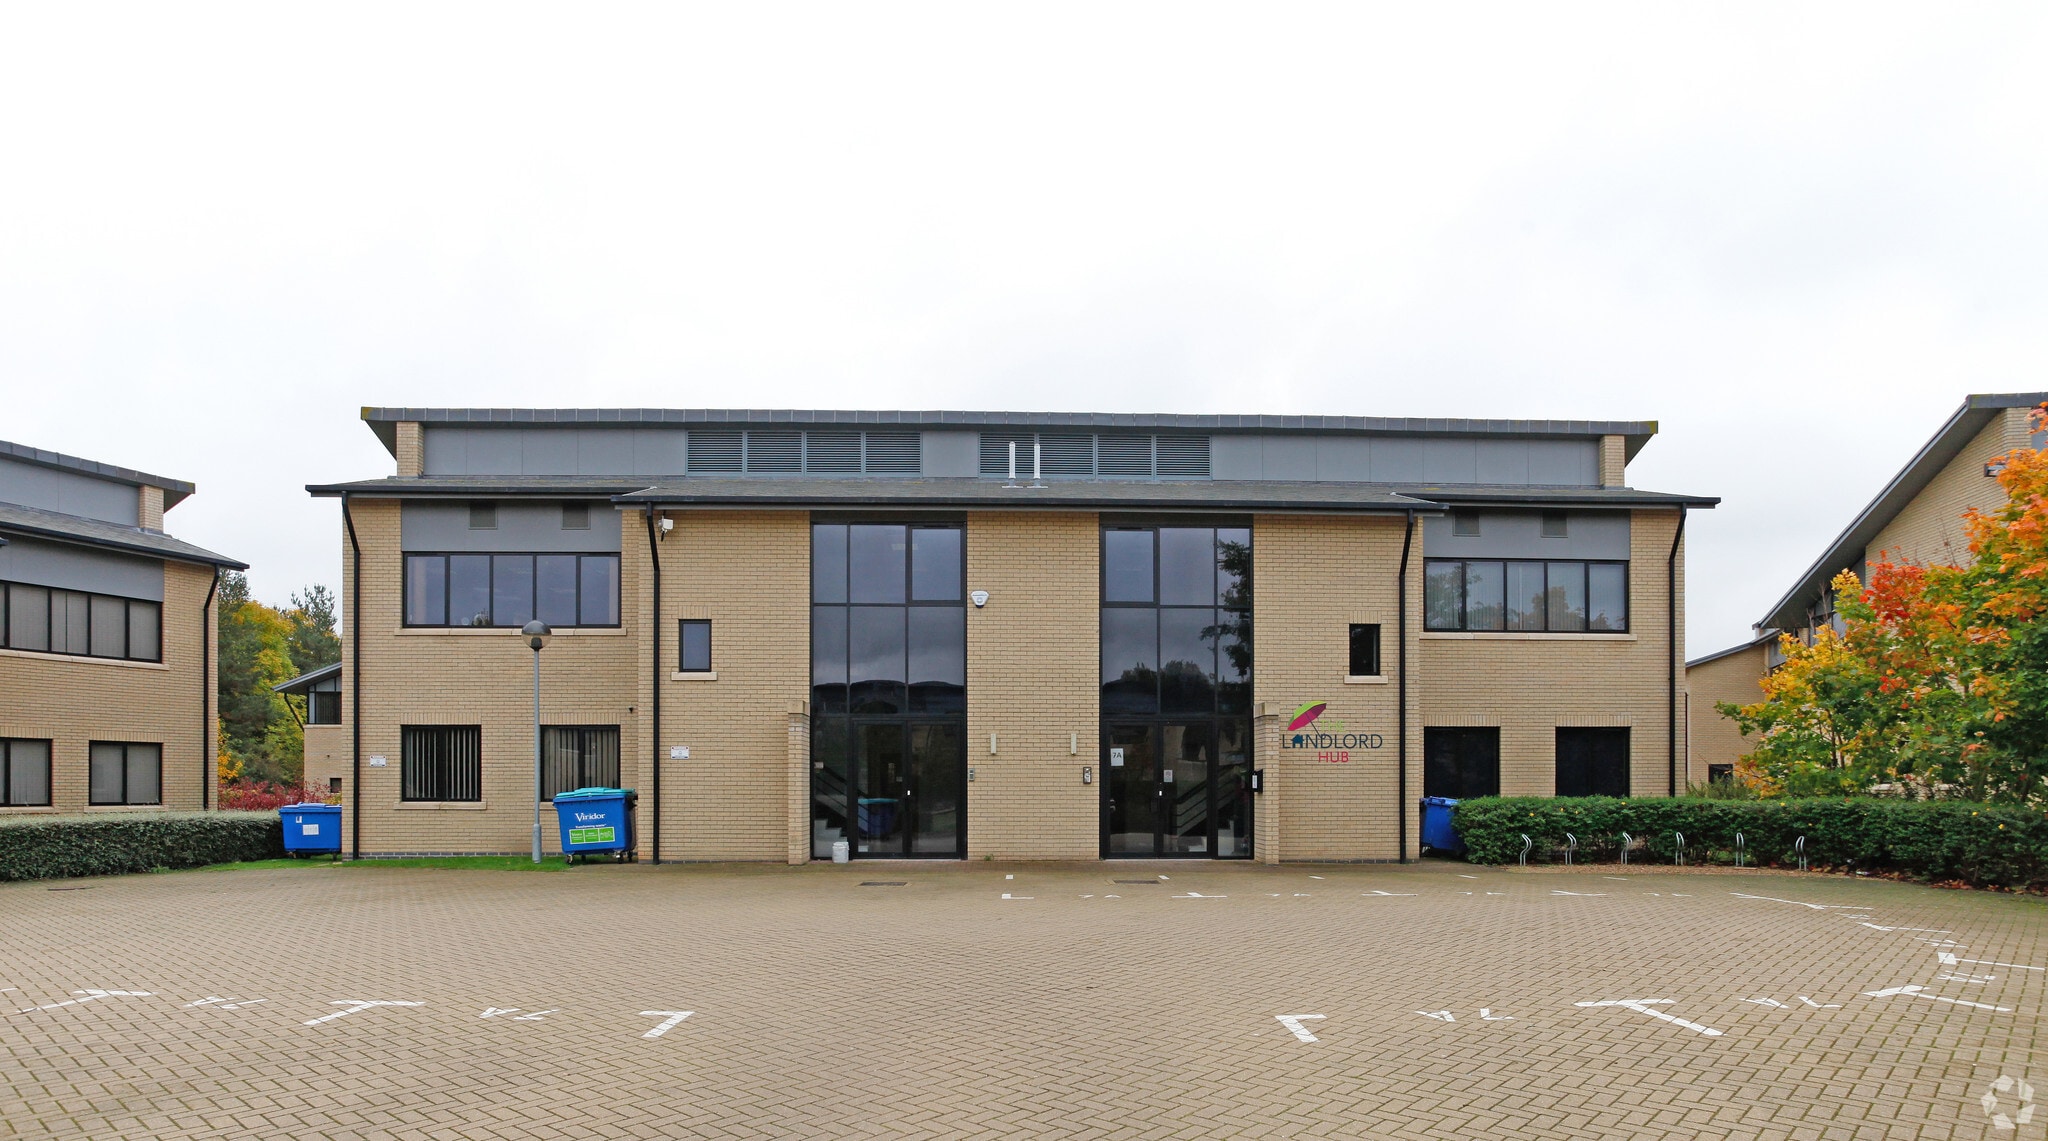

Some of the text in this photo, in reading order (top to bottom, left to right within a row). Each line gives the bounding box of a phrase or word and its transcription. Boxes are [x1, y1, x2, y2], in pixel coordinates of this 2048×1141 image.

[1319, 720, 1345, 732] THE
[1282, 734, 1383, 749] LANDLORD
[1112, 751, 1122, 759] 7A
[1318, 752, 1349, 763] HUB
[575, 812, 606, 822] Viridor
